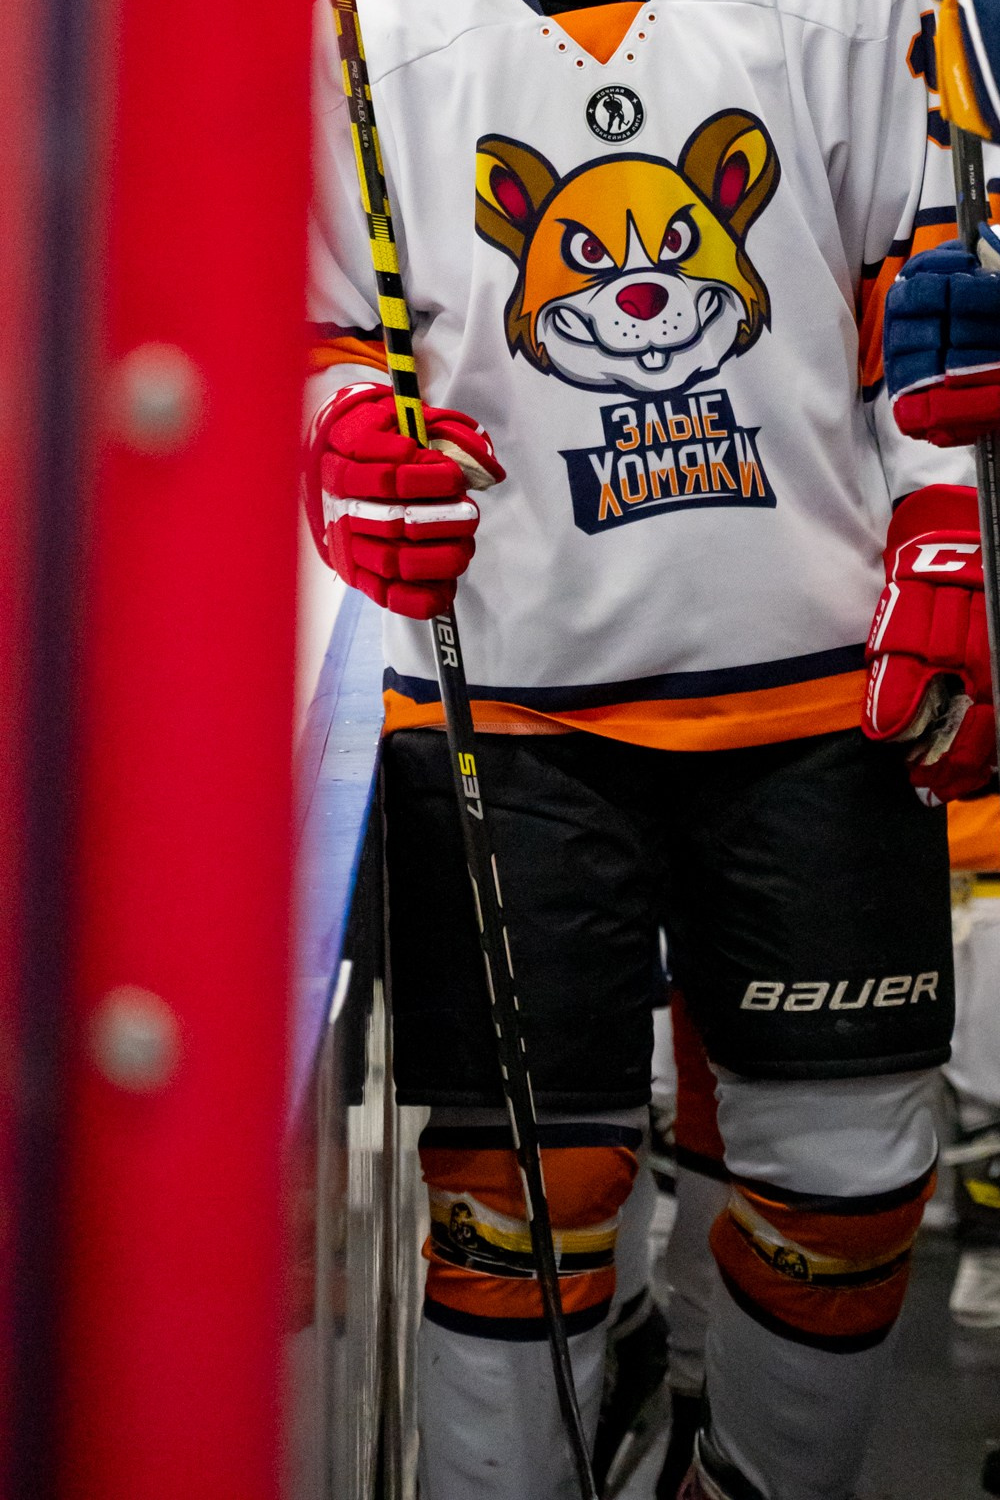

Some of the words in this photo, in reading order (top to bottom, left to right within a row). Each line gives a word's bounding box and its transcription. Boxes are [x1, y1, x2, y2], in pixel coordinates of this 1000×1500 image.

[357, 99, 367, 123] FLEX
[611, 393, 728, 452] ЗЛЫЕ
[588, 432, 766, 521] ХОМЯКИ
[739, 970, 940, 1012] BAUER
